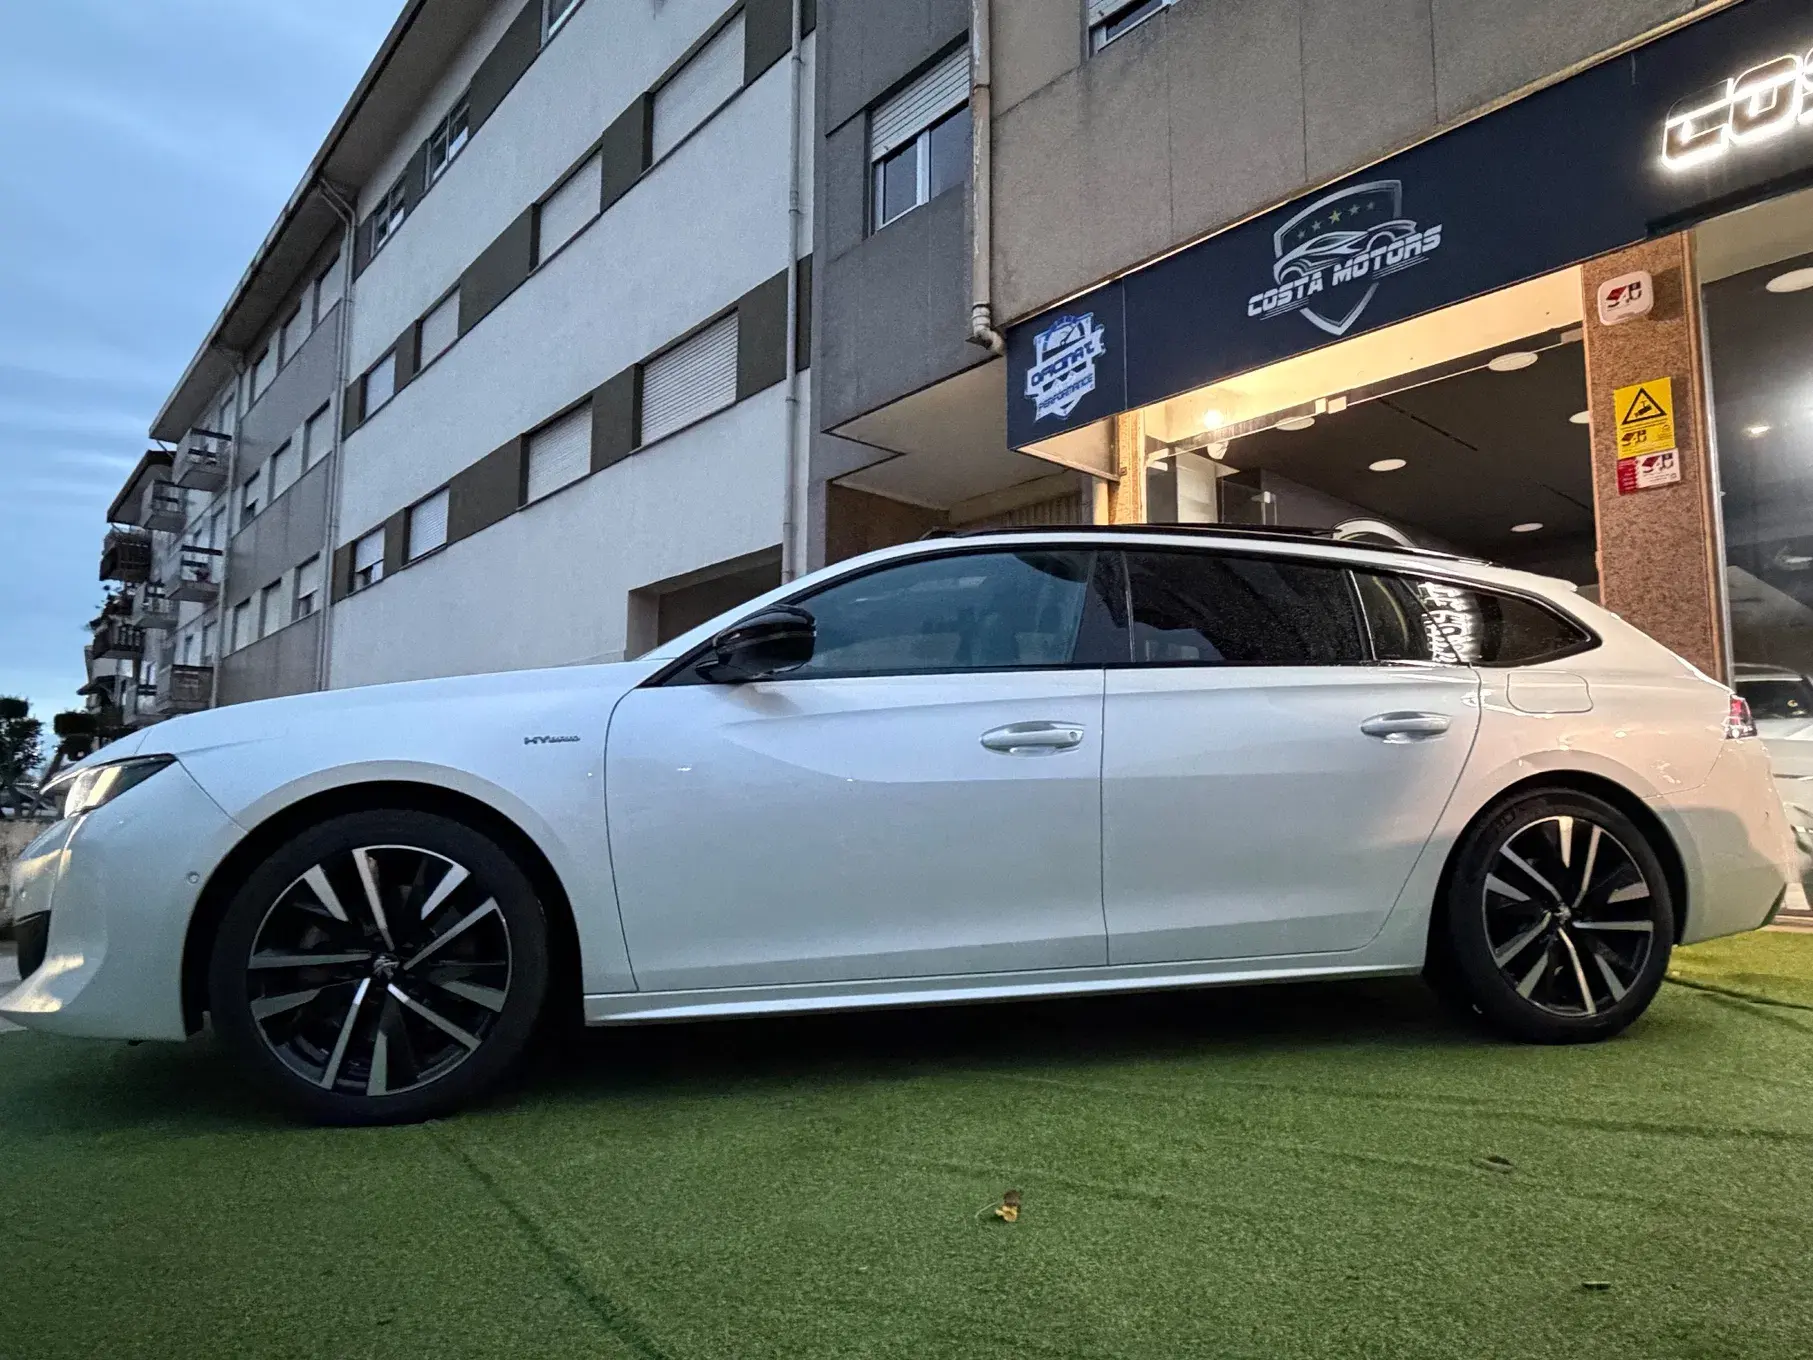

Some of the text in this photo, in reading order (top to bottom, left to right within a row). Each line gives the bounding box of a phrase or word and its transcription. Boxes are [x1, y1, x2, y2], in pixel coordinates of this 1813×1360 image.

[1661, 48, 1813, 169] CO
[1247, 223, 1443, 317] COSTA MOTORS
[1038, 372, 1094, 409] PERFORMANCE
